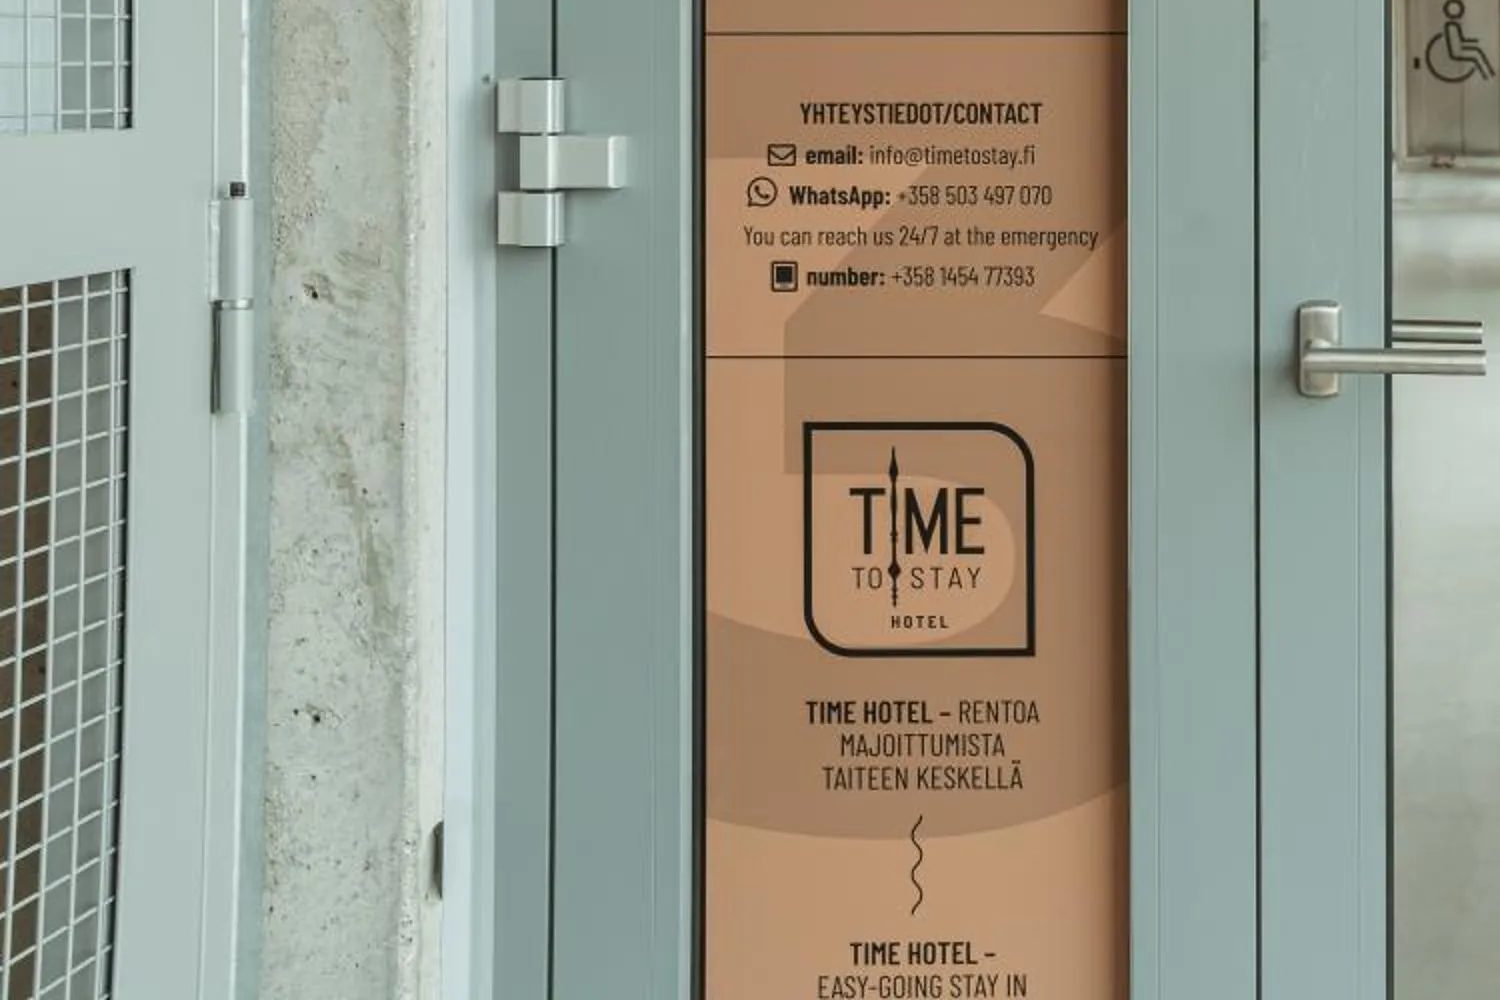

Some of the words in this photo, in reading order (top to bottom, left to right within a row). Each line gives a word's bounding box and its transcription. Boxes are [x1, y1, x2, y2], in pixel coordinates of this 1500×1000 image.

[800, 102, 1043, 126] YHTEYSTIEDOT/CONTACT
[805, 144, 864, 165] email:
[869, 144, 1036, 170] info@timetostay.fi
[788, 185, 891, 210] WhatsApp:
[896, 184, 940, 207] +358
[945, 184, 978, 207] 503
[983, 184, 1015, 207] 497
[1019, 184, 1053, 207] 070
[743, 225, 775, 247] You
[780, 230, 812, 247] can
[817, 225, 868, 247] reach
[873, 231, 895, 247] us
[898, 225, 939, 247] 24/7
[943, 227, 962, 247] at
[967, 225, 996, 247] the
[1000, 230, 1100, 251] emergency
[806, 263, 886, 287] number:
[890, 264, 934, 287] +358
[939, 264, 979, 287] 1454
[984, 264, 1035, 287] 77393
[849, 487, 985, 555] TIME
[851, 566, 883, 591] TO
[909, 566, 982, 591] STAY
[890, 614, 949, 630] HOTEL
[805, 700, 857, 725] TIME
[863, 700, 934, 725] HOTEL
[958, 700, 1040, 725] RENTOA
[840, 733, 1006, 758] MAJOITTUMISTA
[821, 765, 909, 791] TAITEEN
[916, 760, 1024, 791] KESKELLÄ
[849, 941, 901, 966] TIME
[907, 941, 979, 966] HOTEL
[817, 973, 944, 1000] EASY-GOING
[949, 973, 999, 1000] STAY
[1006, 973, 1028, 1000] IN
